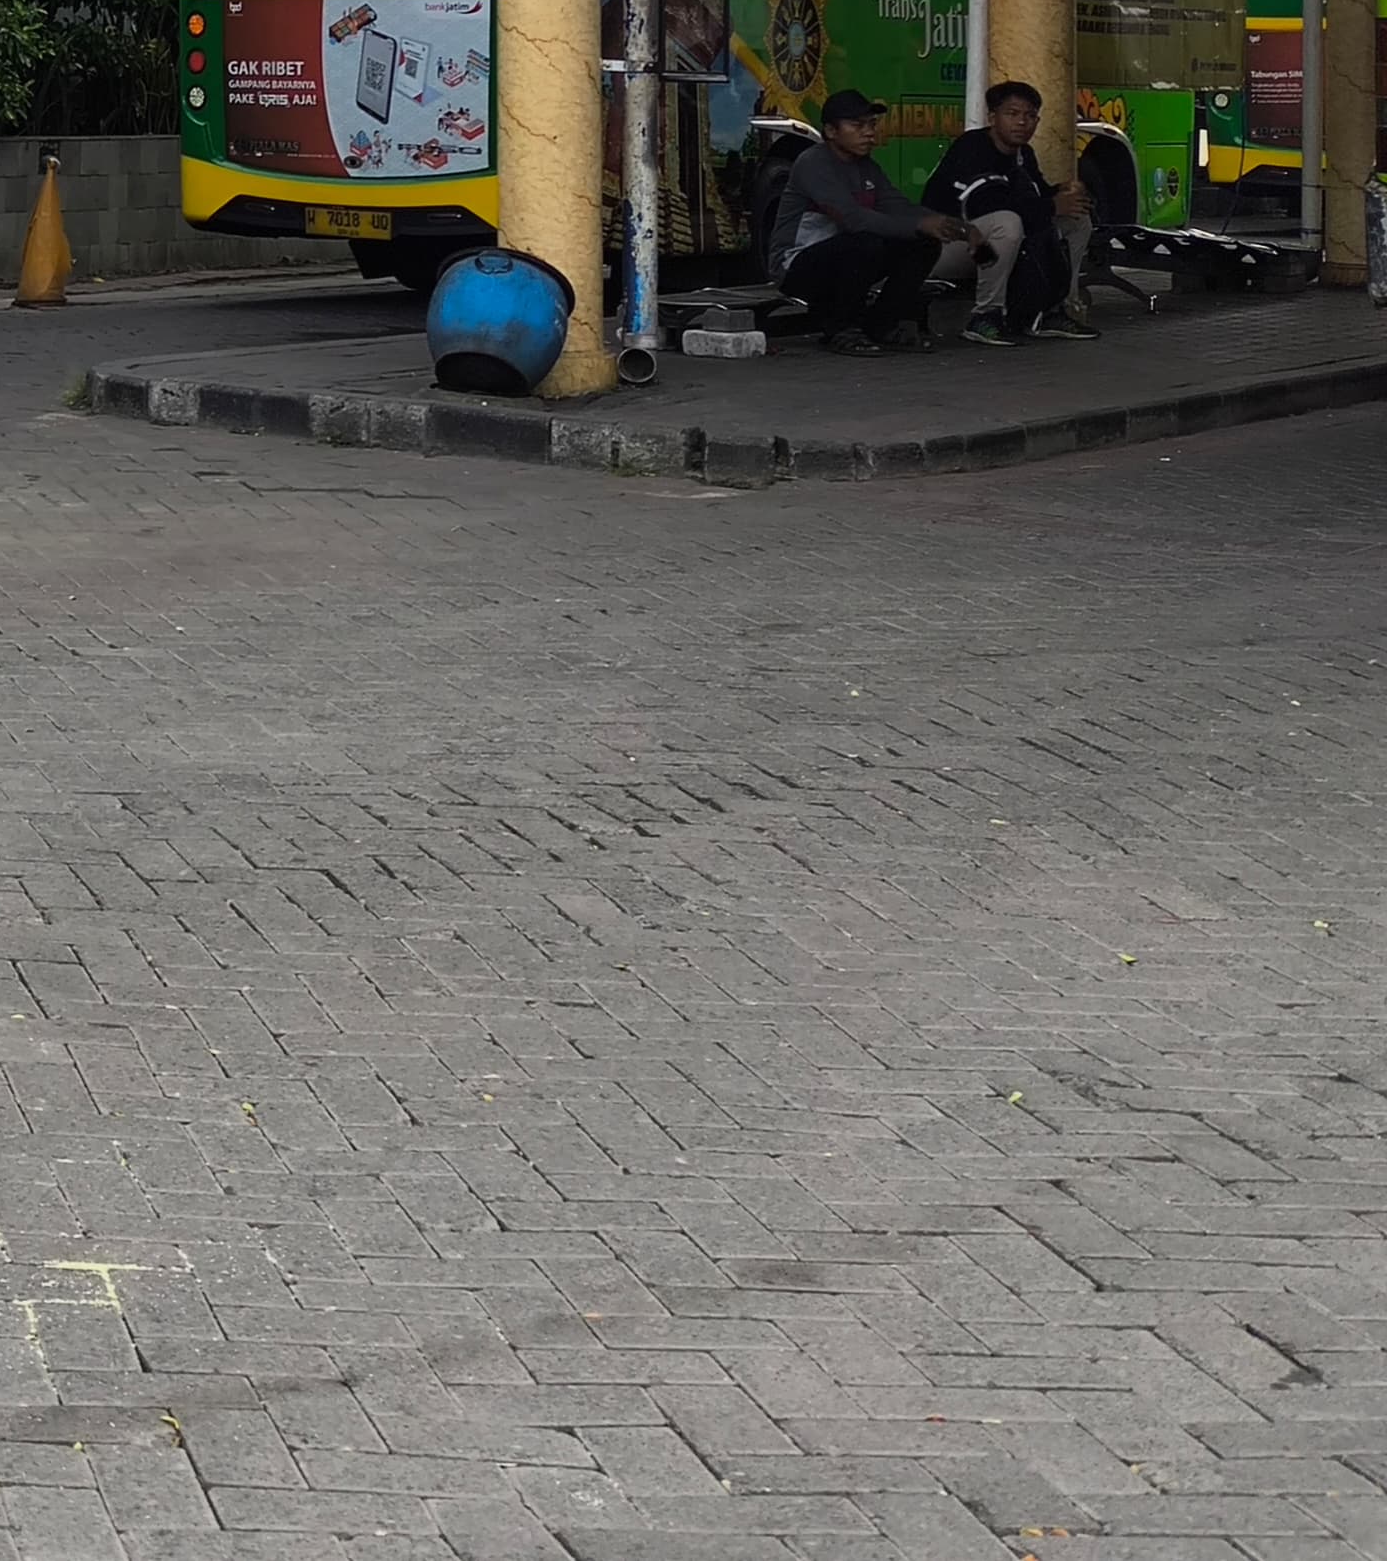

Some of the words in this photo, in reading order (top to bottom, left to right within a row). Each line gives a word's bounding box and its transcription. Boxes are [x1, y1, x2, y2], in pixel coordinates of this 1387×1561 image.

[228, 61, 259, 75] GAK
[262, 61, 305, 76] RIBET
[228, 79, 271, 89] GAMPANG
[272, 80, 316, 89] BAYARNYA
[229, 93, 255, 104] PAKE
